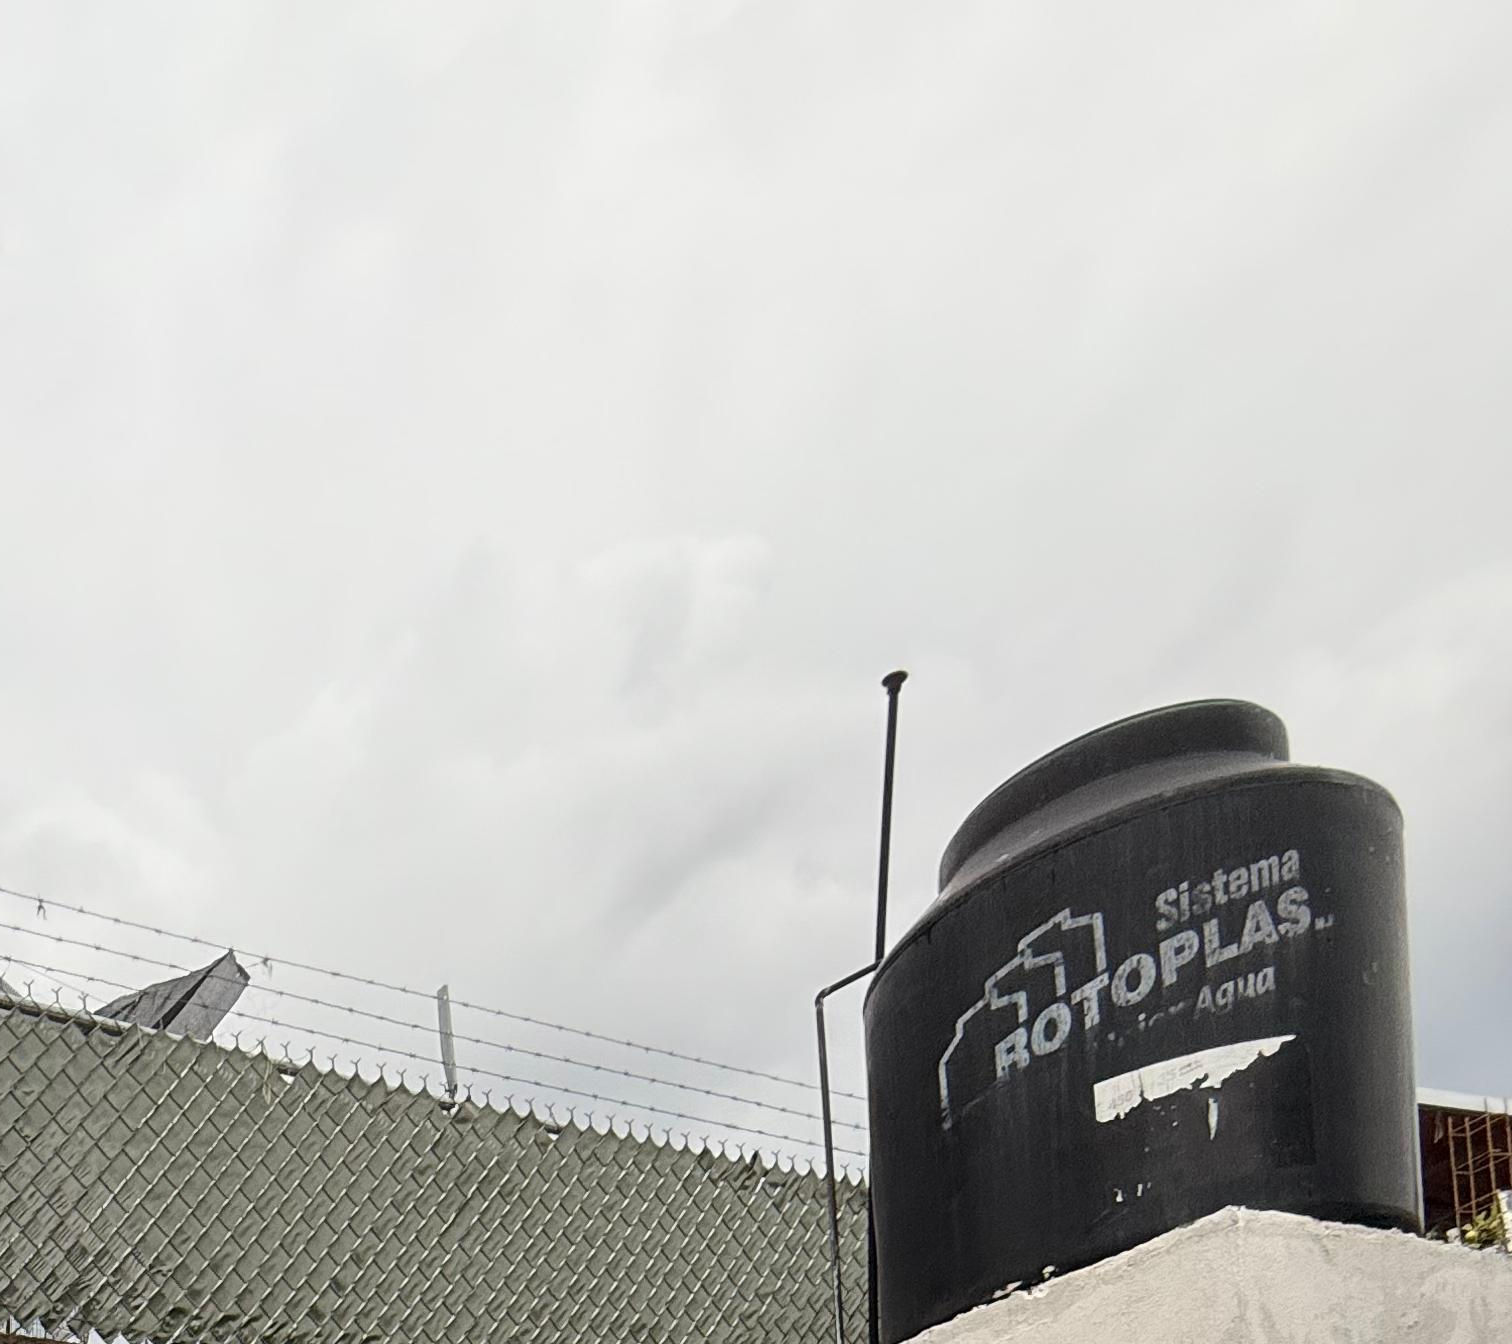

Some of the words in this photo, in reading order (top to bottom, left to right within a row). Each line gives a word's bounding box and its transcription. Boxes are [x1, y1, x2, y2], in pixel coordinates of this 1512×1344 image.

[1155, 849, 1300, 932] Sistema
[994, 885, 1313, 1081] ROTOPLAS
[1193, 965, 1277, 1021] Agua
